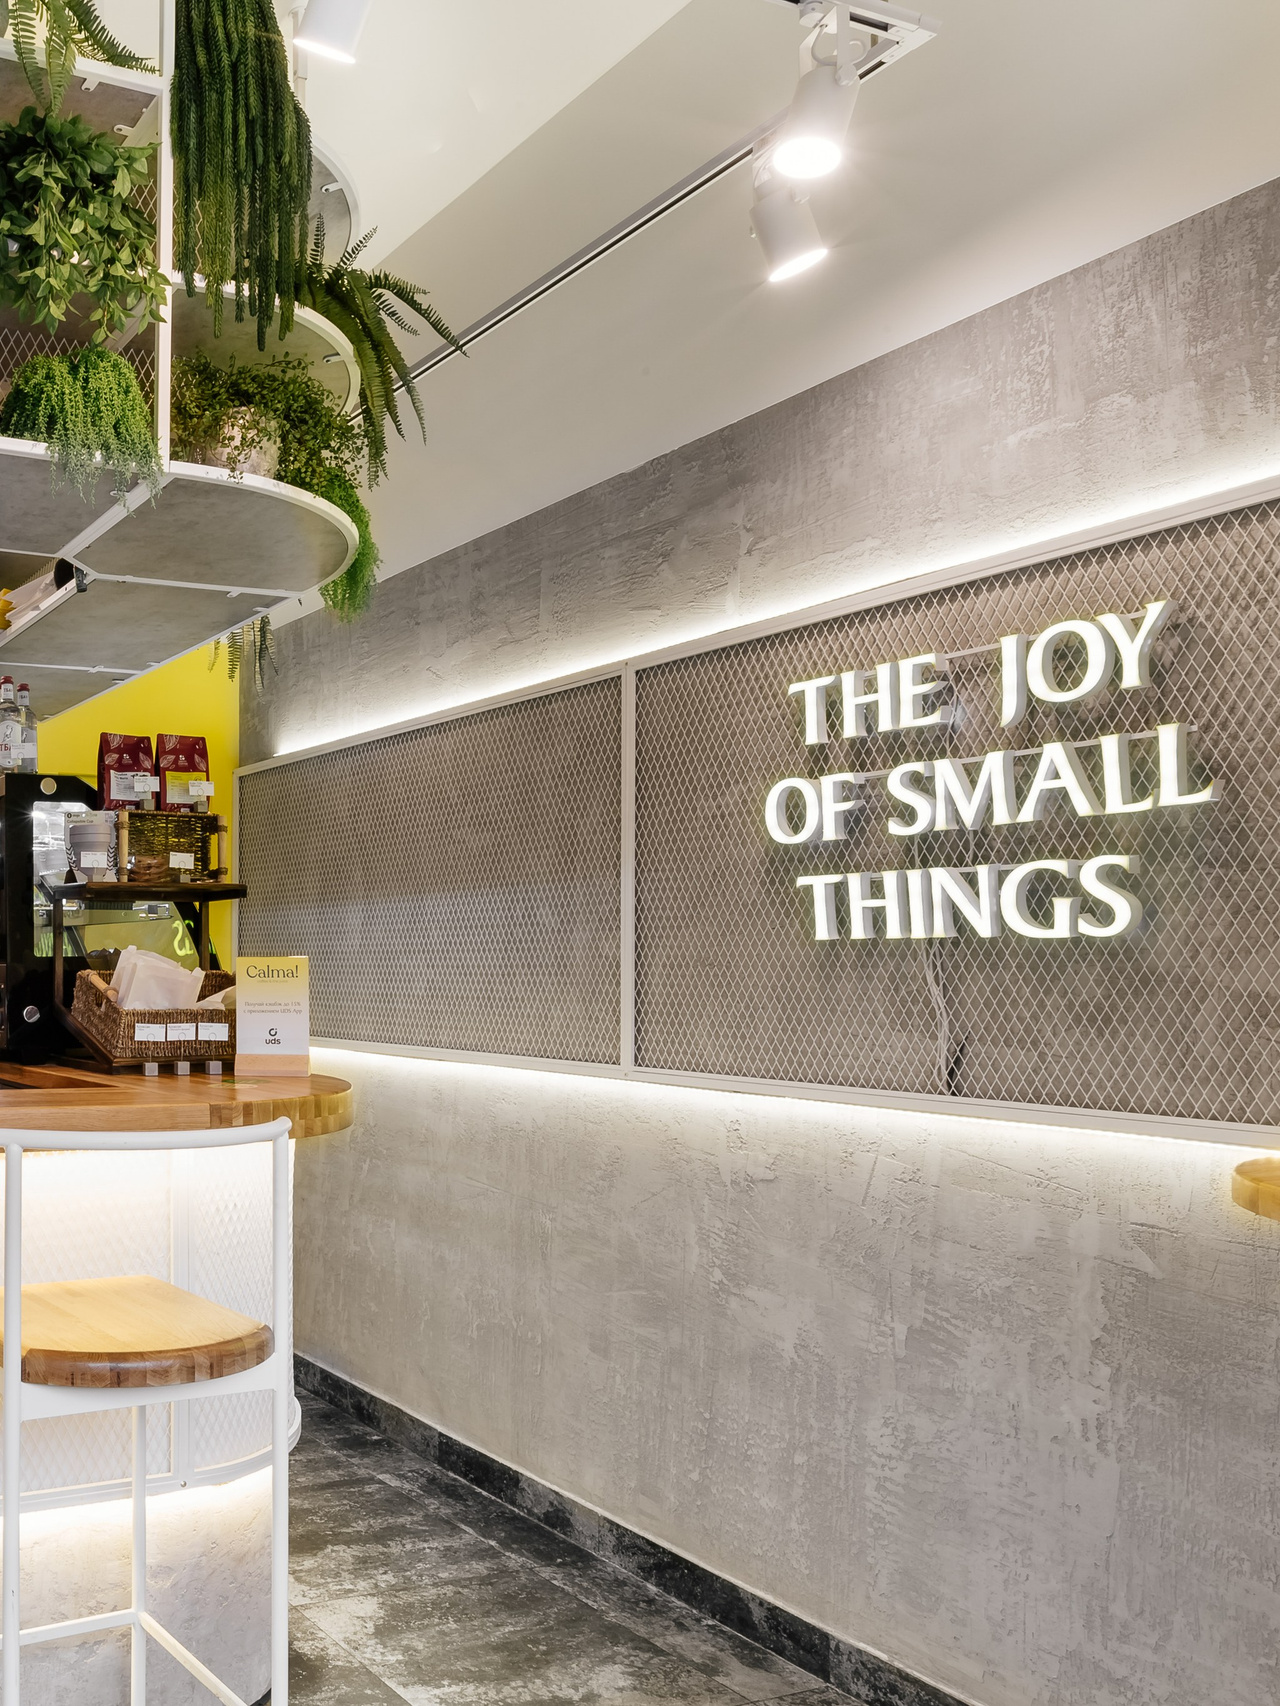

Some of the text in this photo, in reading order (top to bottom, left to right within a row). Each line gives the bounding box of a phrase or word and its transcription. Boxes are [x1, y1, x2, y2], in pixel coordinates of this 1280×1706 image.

[788, 600, 1177, 746] THE JOY
[765, 722, 1225, 845] OF SMALL
[796, 854, 1142, 940] THINGS
[246, 965, 298, 978] Calma!
